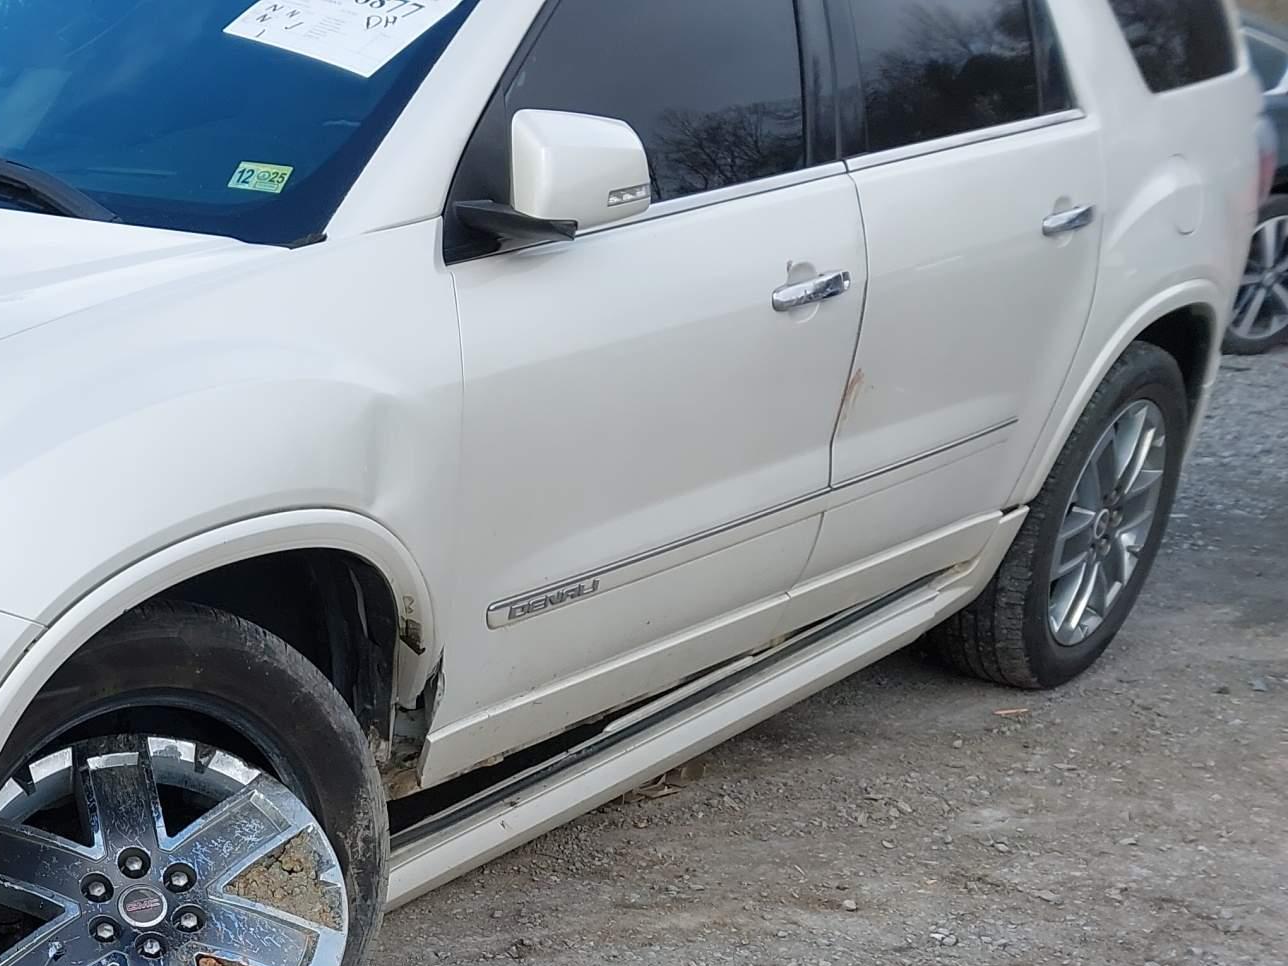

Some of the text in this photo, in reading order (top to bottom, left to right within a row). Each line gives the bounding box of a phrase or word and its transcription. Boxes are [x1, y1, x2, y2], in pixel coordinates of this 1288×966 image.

[235, 168, 288, 184] 12 25
[508, 579, 600, 620] DENALI
